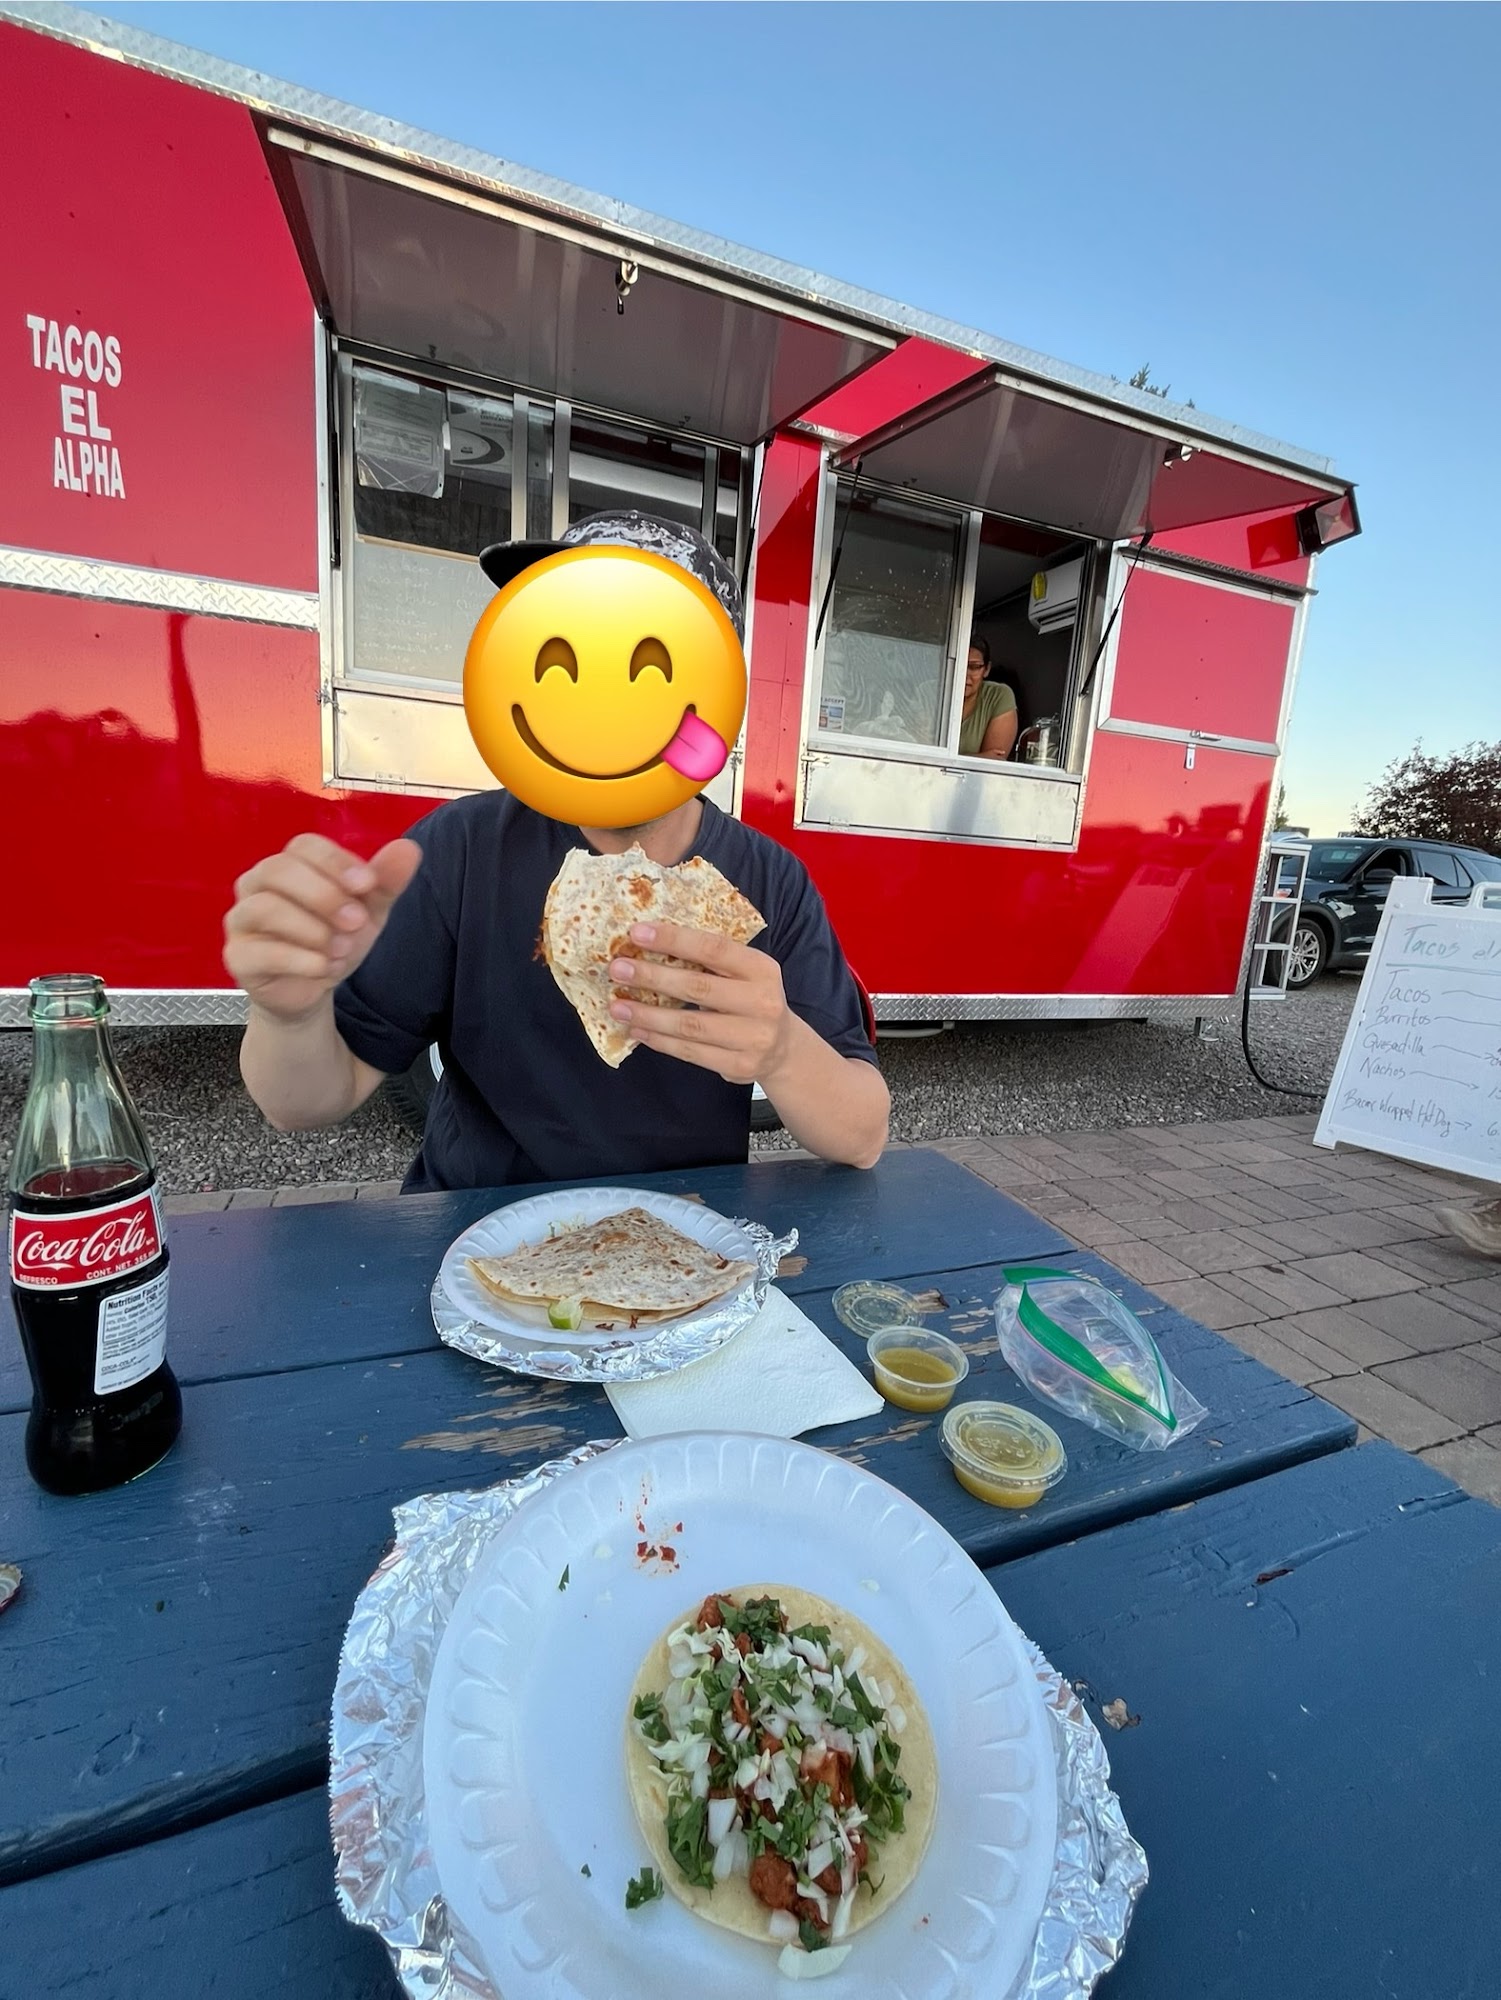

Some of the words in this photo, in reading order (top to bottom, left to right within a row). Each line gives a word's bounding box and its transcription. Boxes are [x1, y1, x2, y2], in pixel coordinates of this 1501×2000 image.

[27, 313, 122, 388] TACOS
[60, 384, 112, 441] EL
[54, 436, 126, 499] ALPHA
[1403, 924, 1460, 959] Tacos
[1381, 969, 1432, 1004] Tacos
[1365, 1005, 1432, 1031] Burritos
[1362, 1032, 1425, 1057] Quesadilla
[1359, 1056, 1406, 1079] Nachos
[17, 1209, 147, 1270] Coca-Cola
[19, 1273, 58, 1285] REFRESCO
[107, 1293, 141, 1310] Nutrition
